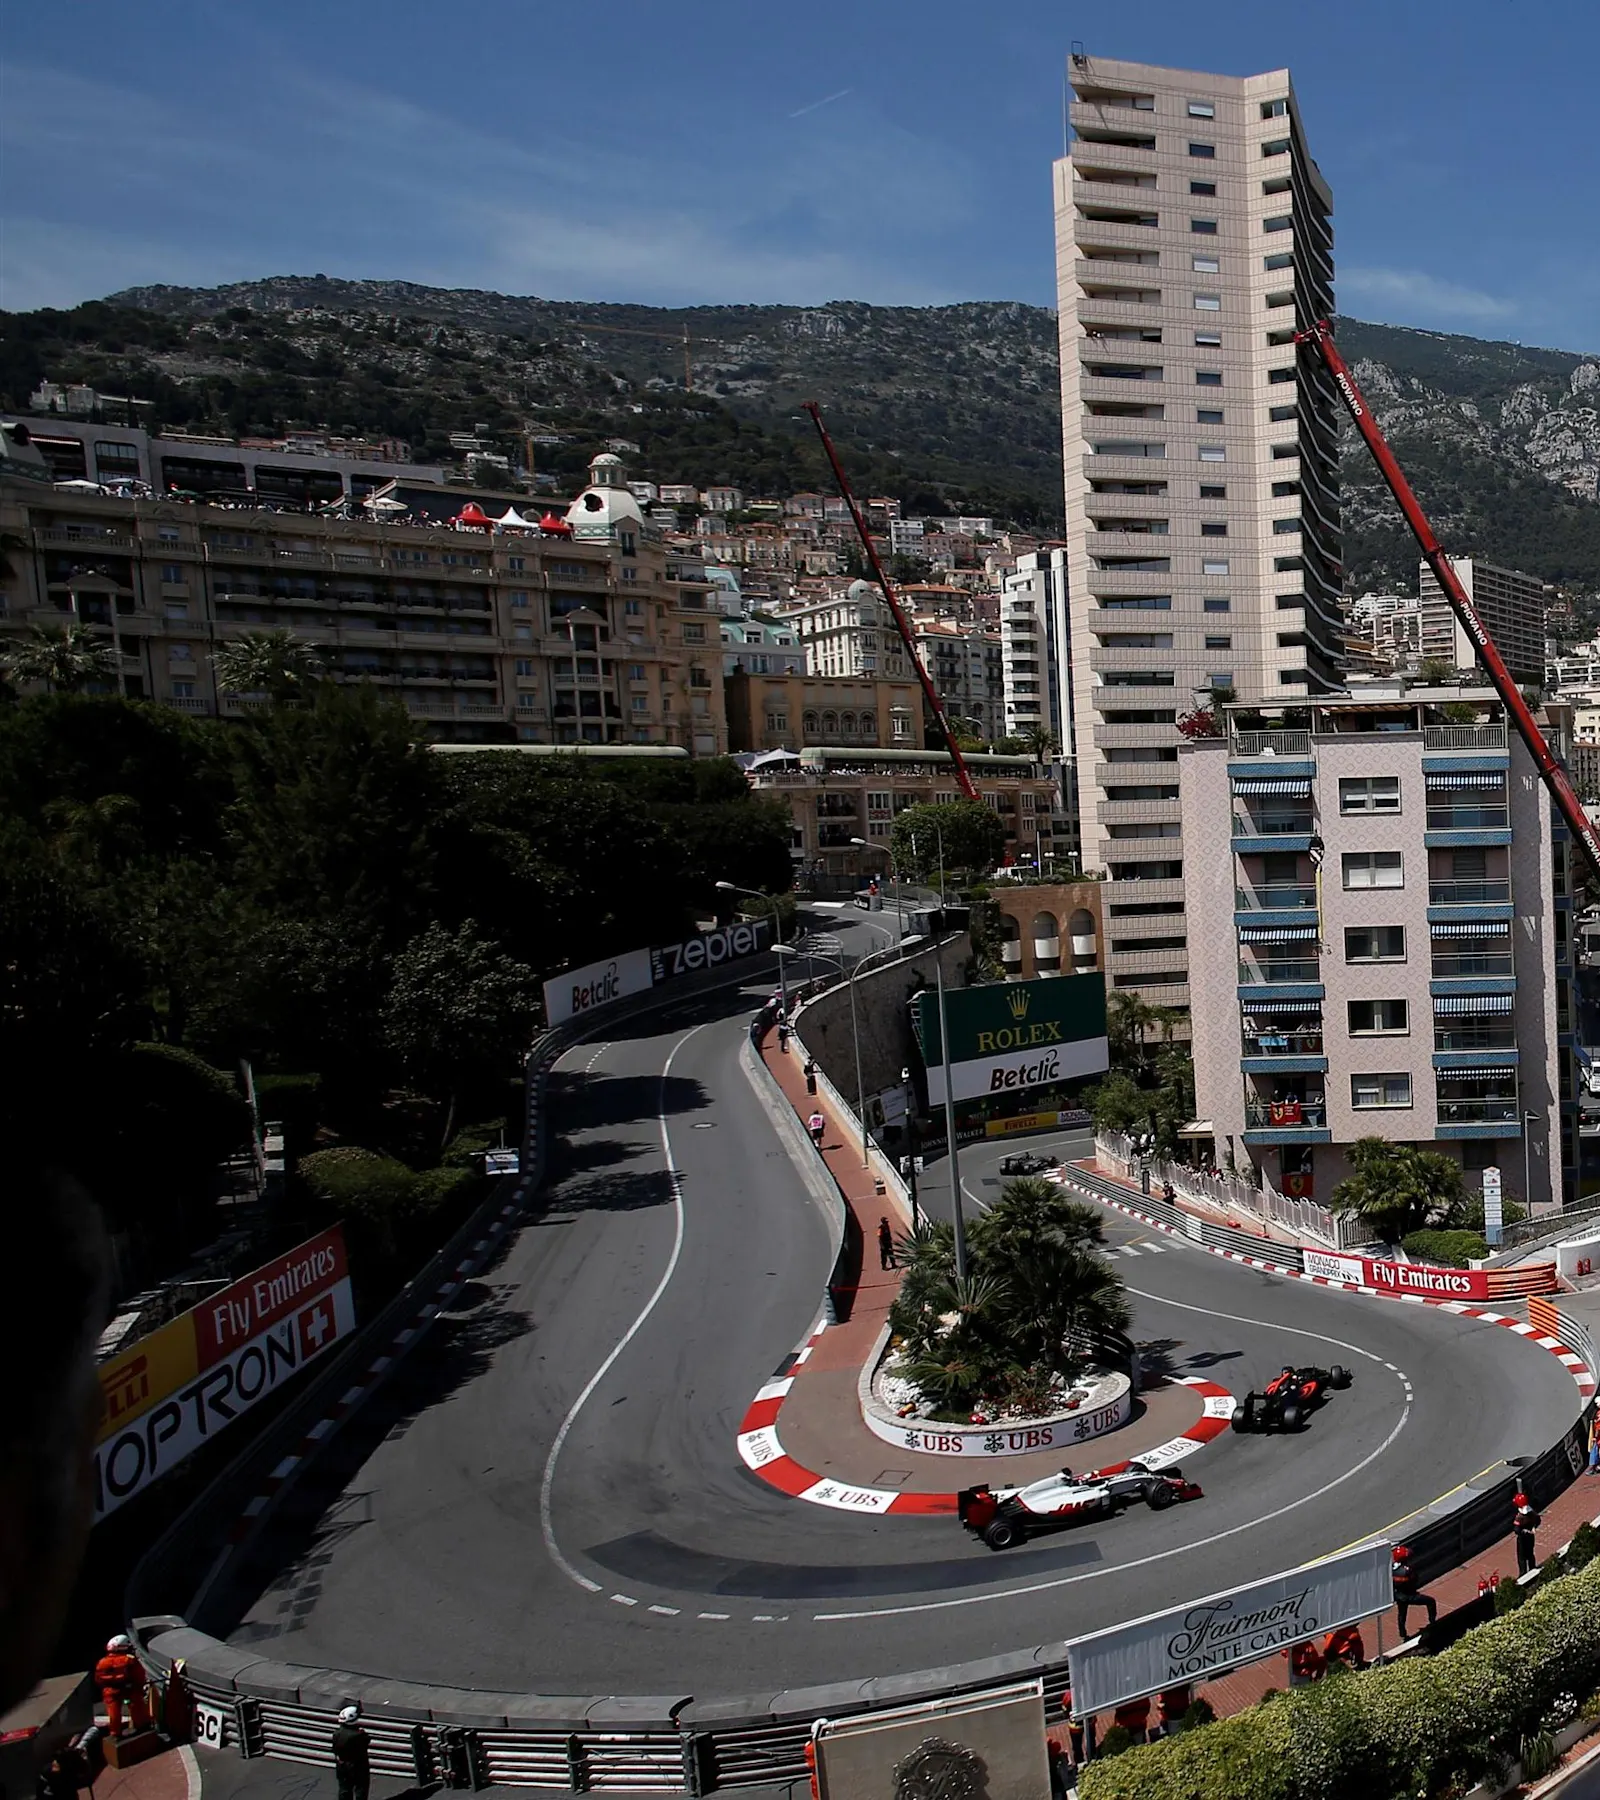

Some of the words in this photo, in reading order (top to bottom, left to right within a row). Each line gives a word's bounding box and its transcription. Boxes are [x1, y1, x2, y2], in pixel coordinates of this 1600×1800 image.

[1336, 372, 1363, 417] PIOVANO
[1460, 602, 1488, 646] PIOVANO
[662, 919, 769, 974] zepter
[572, 961, 620, 1013] Betclic
[977, 1021, 1063, 1052] ROLEX
[990, 1049, 1060, 1091] Betclic
[956, 1129, 984, 1140] WALKER
[1005, 1117, 1037, 1130] PIRELLI
[1307, 1254, 1340, 1270] MONACO
[1372, 1263, 1395, 1287] Fly
[1397, 1267, 1471, 1292] Emirates
[213, 1297, 250, 1344] Fly
[253, 1246, 336, 1316] Emirates
[93, 1320, 296, 1513] IOPTRON
[1092, 1404, 1121, 1432] UBS
[750, 1440, 774, 1463] UBS
[923, 1434, 963, 1452] UBS
[1007, 1427, 1053, 1450] UBS
[1158, 1436, 1194, 1457] UBS
[838, 1490, 884, 1507] UBS
[1167, 1587, 1315, 1660] Fairmont
[1168, 1642, 1243, 1681] MONTE
[1250, 1617, 1318, 1651] CARLO
[194, 1711, 218, 1741] SC
